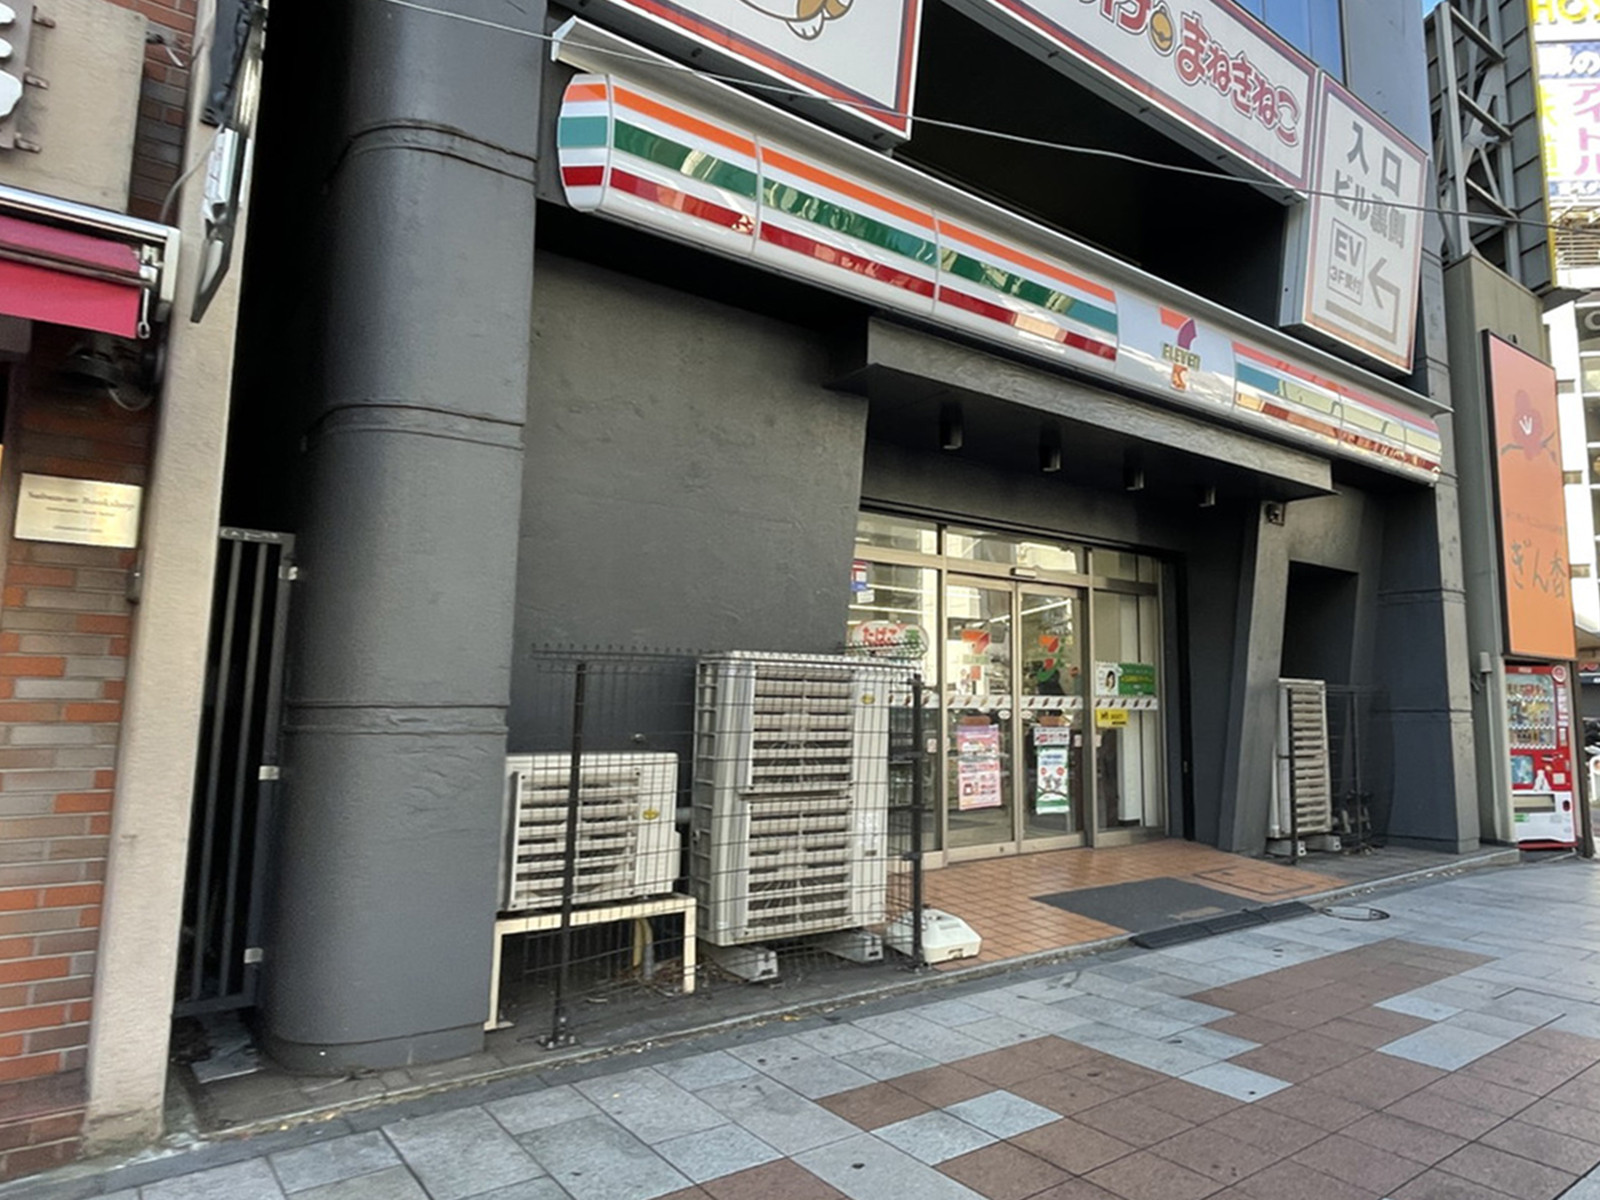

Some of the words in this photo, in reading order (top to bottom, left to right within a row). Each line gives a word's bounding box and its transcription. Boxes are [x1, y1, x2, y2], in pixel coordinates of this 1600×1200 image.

[1175, 12, 1299, 146] まねきねこ
[1347, 121, 1402, 197] 入口
[1334, 228, 1362, 268] EV
